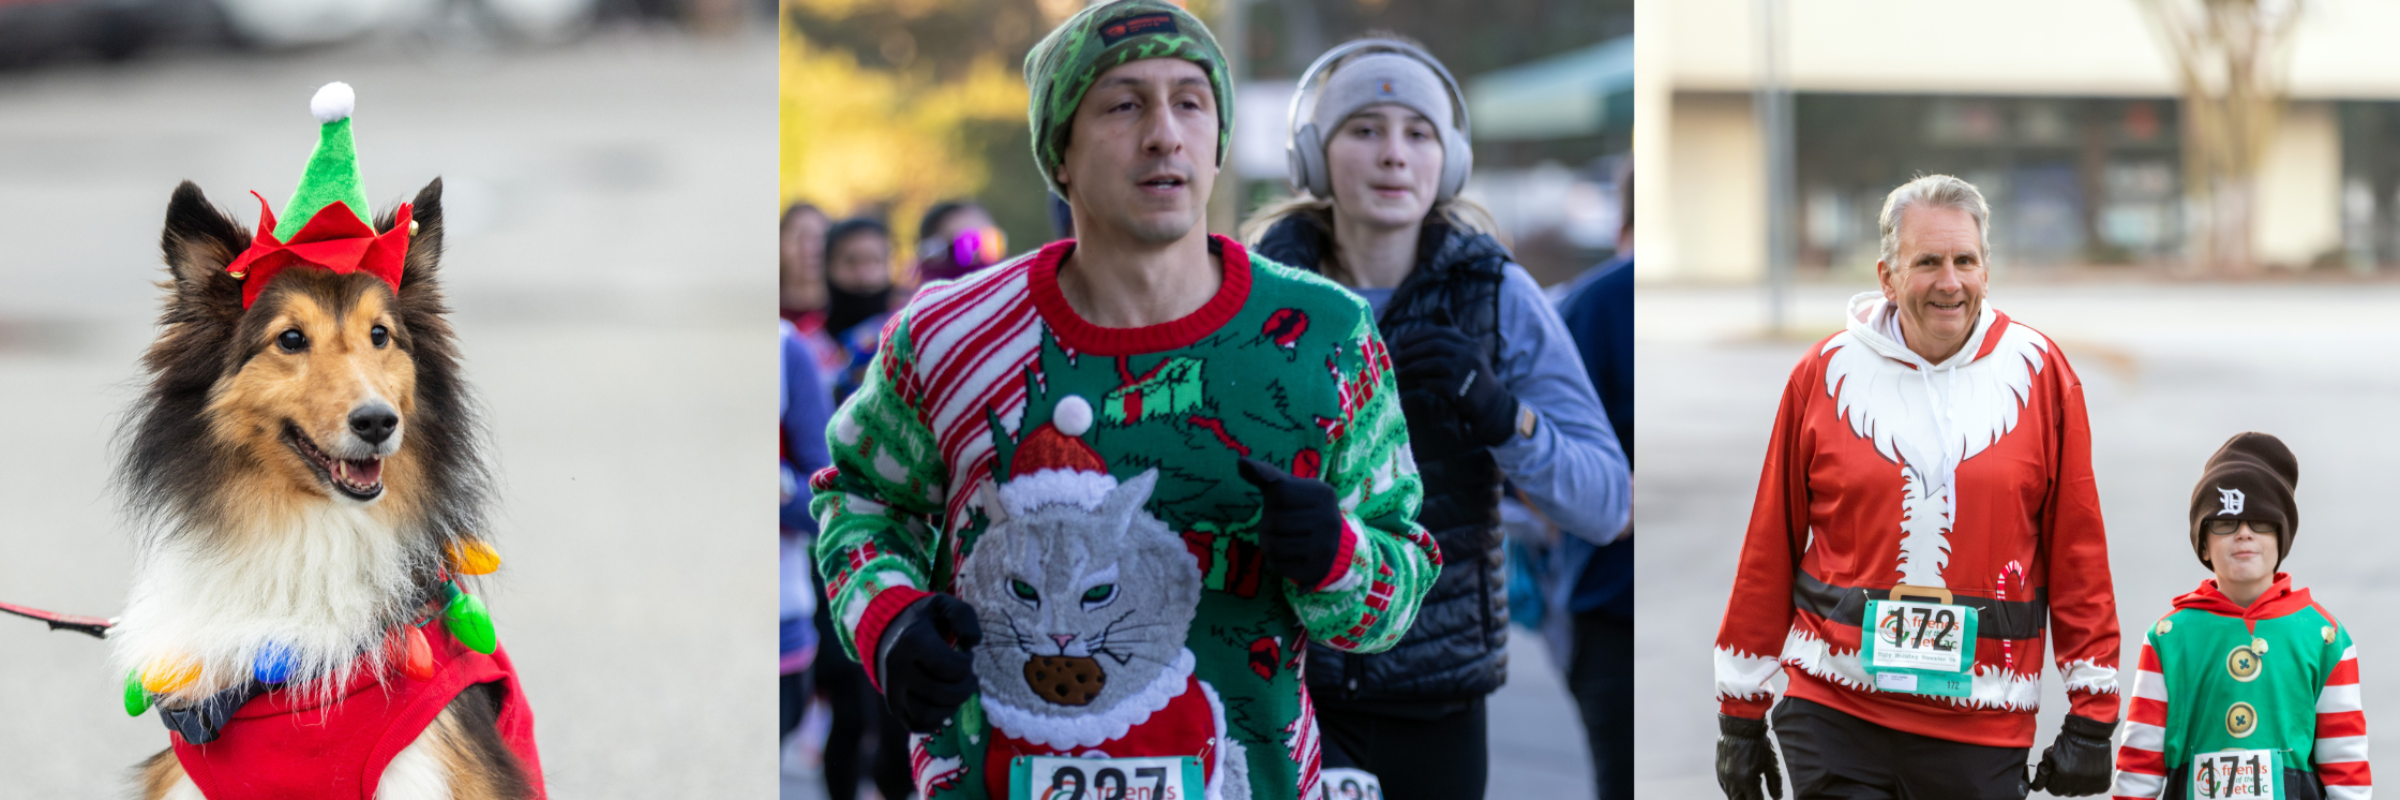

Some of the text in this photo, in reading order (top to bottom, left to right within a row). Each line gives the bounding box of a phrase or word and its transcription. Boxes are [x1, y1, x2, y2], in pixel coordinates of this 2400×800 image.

[2217, 486, 2245, 516] D
[1890, 606, 1956, 652] 172
[1912, 615, 1960, 631] frens
[1910, 637, 1958, 650] etac
[1947, 680, 1960, 690] 172
[2203, 755, 2261, 799] 171
[2222, 763, 2268, 777] frens
[1096, 785, 1177, 800] frens
[2222, 783, 2269, 796] etcc
